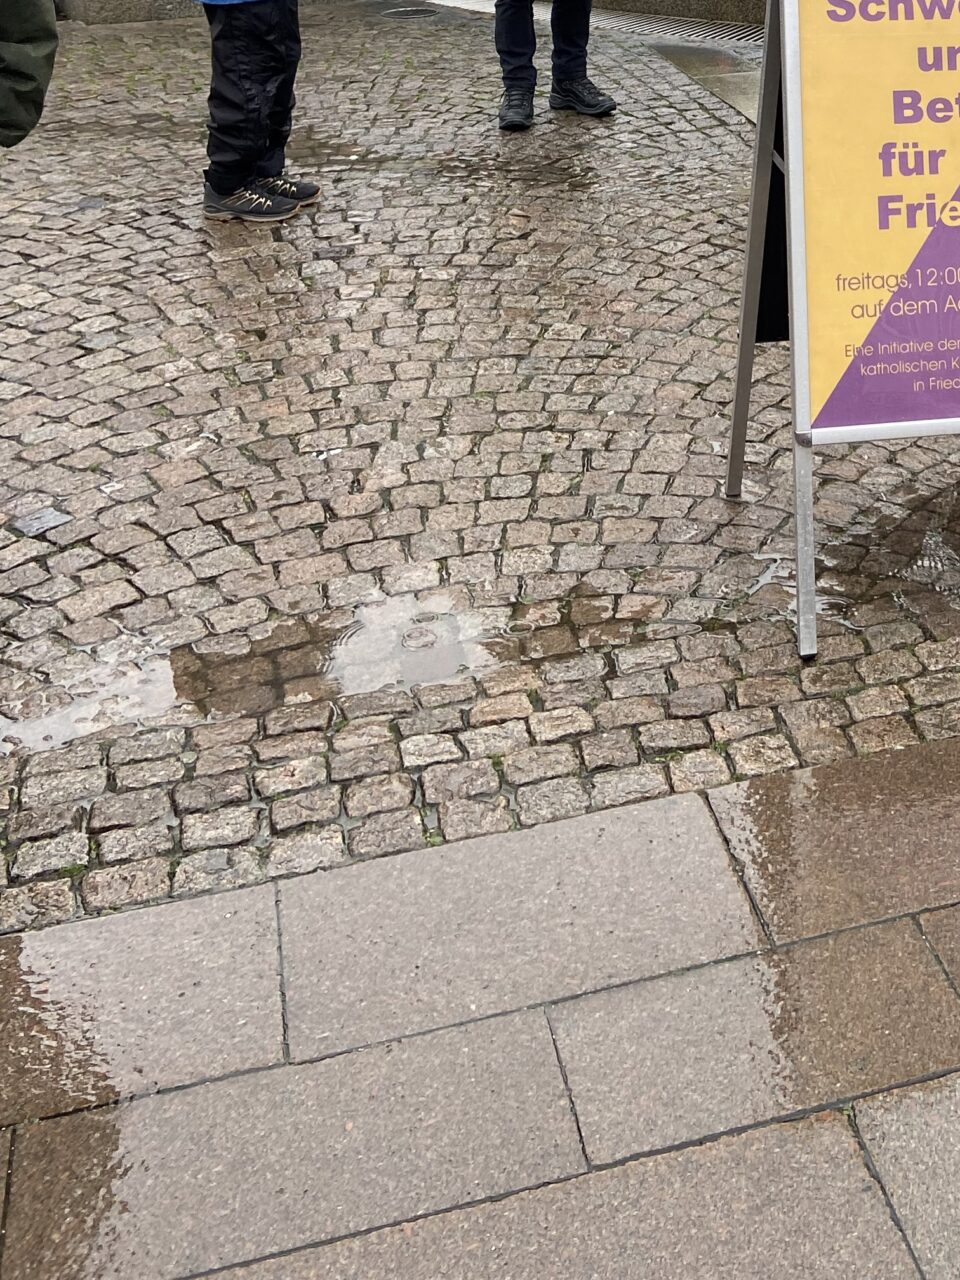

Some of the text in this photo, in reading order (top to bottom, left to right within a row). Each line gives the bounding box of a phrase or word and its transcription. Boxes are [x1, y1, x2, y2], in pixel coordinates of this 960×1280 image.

[878, 141, 947, 177] für
[836, 272, 912, 293] freitags,
[850, 299, 884, 319] auf
[890, 297, 938, 317] dem
[844, 344, 874, 358] Eine
[878, 340, 934, 355] Initiative
[937, 338, 960, 351] der
[860, 359, 947, 377] katholischen
[913, 379, 926, 392] in
